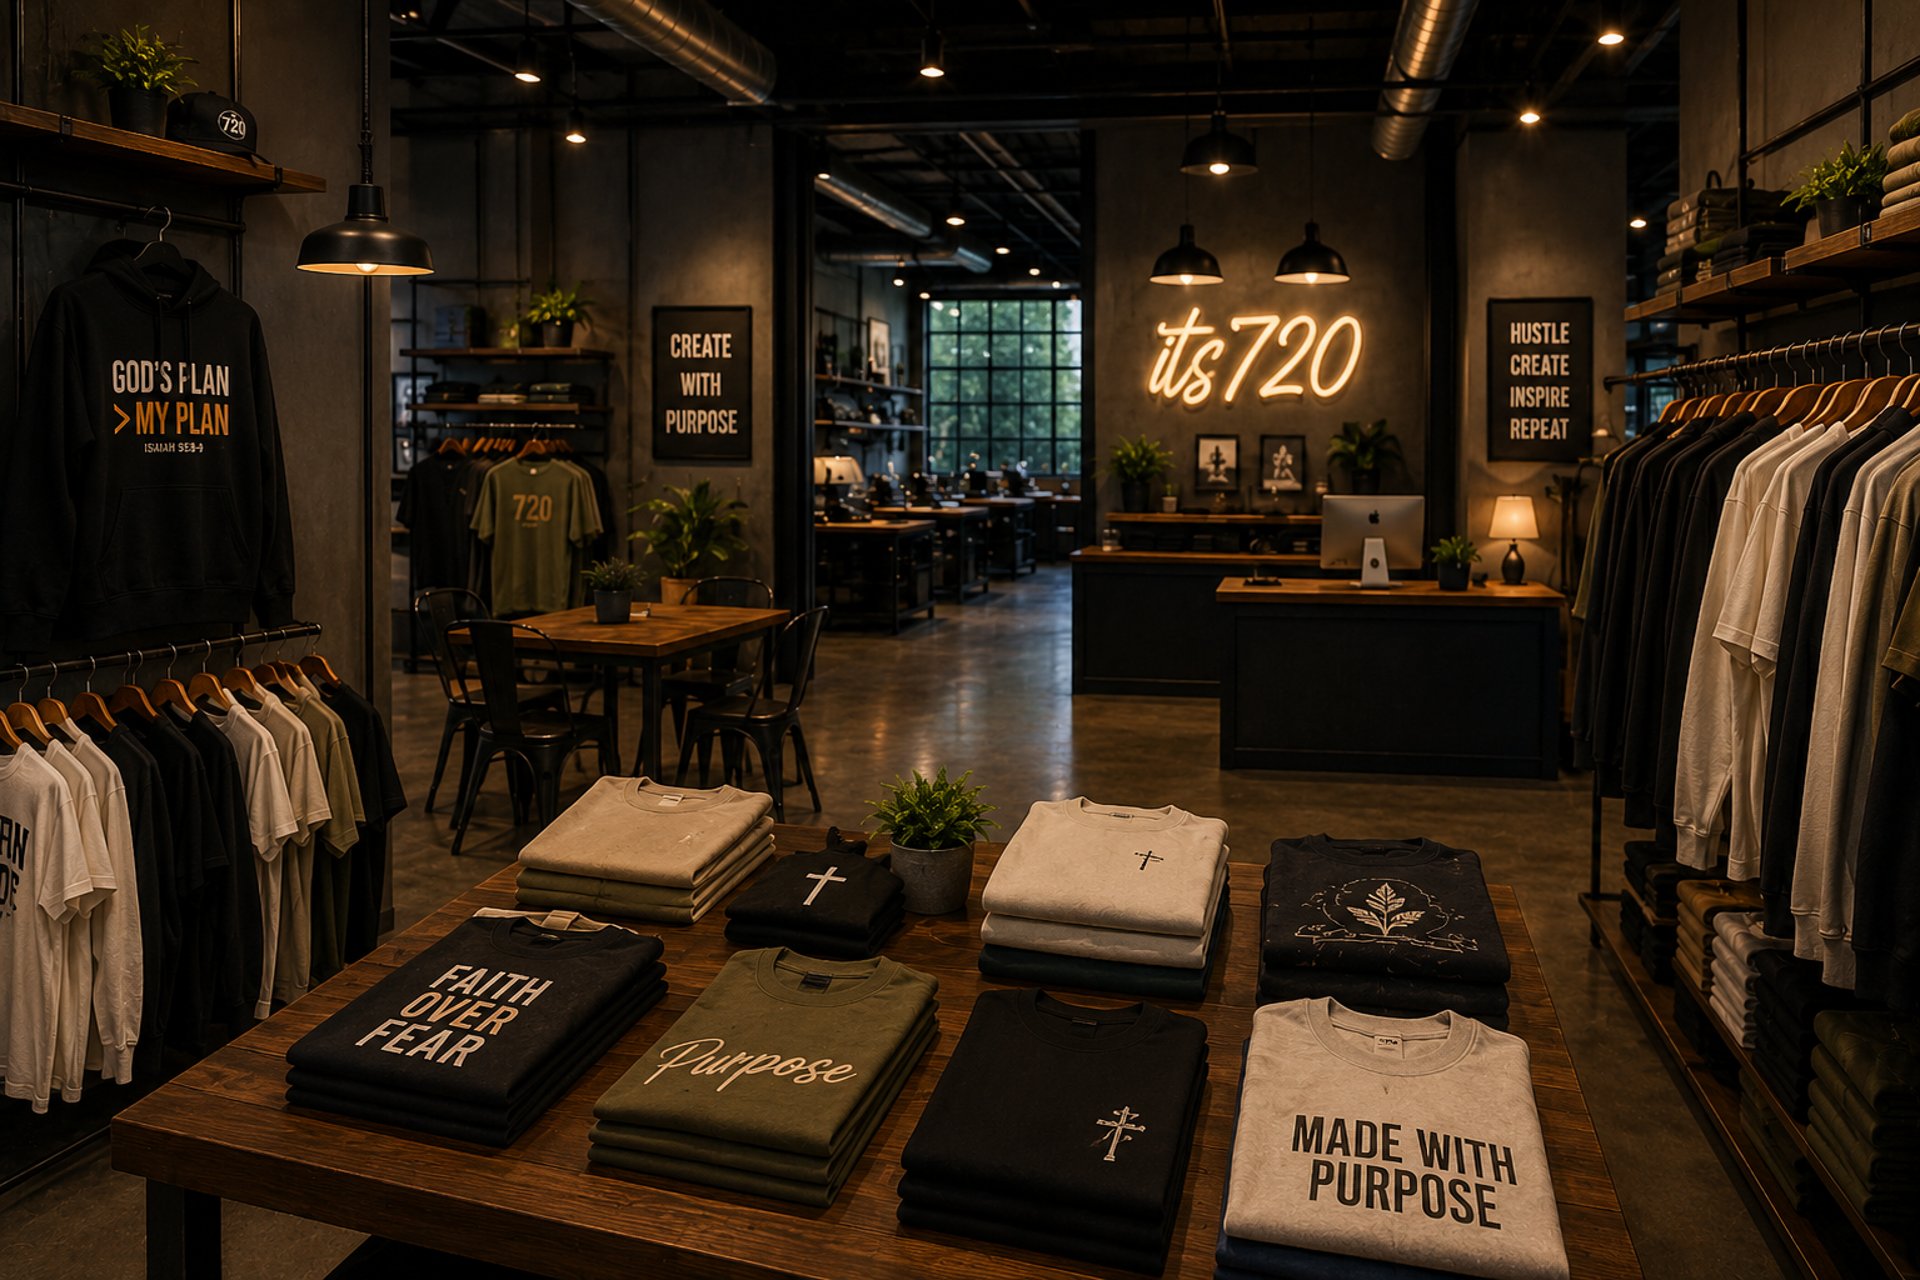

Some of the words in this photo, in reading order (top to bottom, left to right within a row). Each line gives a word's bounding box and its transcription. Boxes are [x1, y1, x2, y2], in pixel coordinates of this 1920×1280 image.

[222, 115, 246, 136] 720
[670, 333, 732, 358] CREATE
[1510, 322, 1570, 344] HUSTLE
[112, 359, 173, 394] GOD'S
[178, 361, 229, 397] PLAN
[1510, 354, 1570, 376] CREATE
[680, 372, 721, 396] WITH
[1510, 386, 1570, 408] INSPIRE
[135, 401, 169, 435] MY
[176, 401, 229, 436] PLAN
[665, 409, 738, 434] PURPOSE
[1510, 418, 1570, 440] REPEAT
[513, 494, 553, 522] 720
[429, 964, 554, 1006] FAITH
[400, 991, 519, 1036] OVER
[354, 1018, 486, 1068] FEAR
[643, 1038, 858, 1092] Purpose
[1291, 1114, 1403, 1164] MADE
[1416, 1128, 1518, 1186] WITH
[1309, 1158, 1502, 1231] PURPOSE
